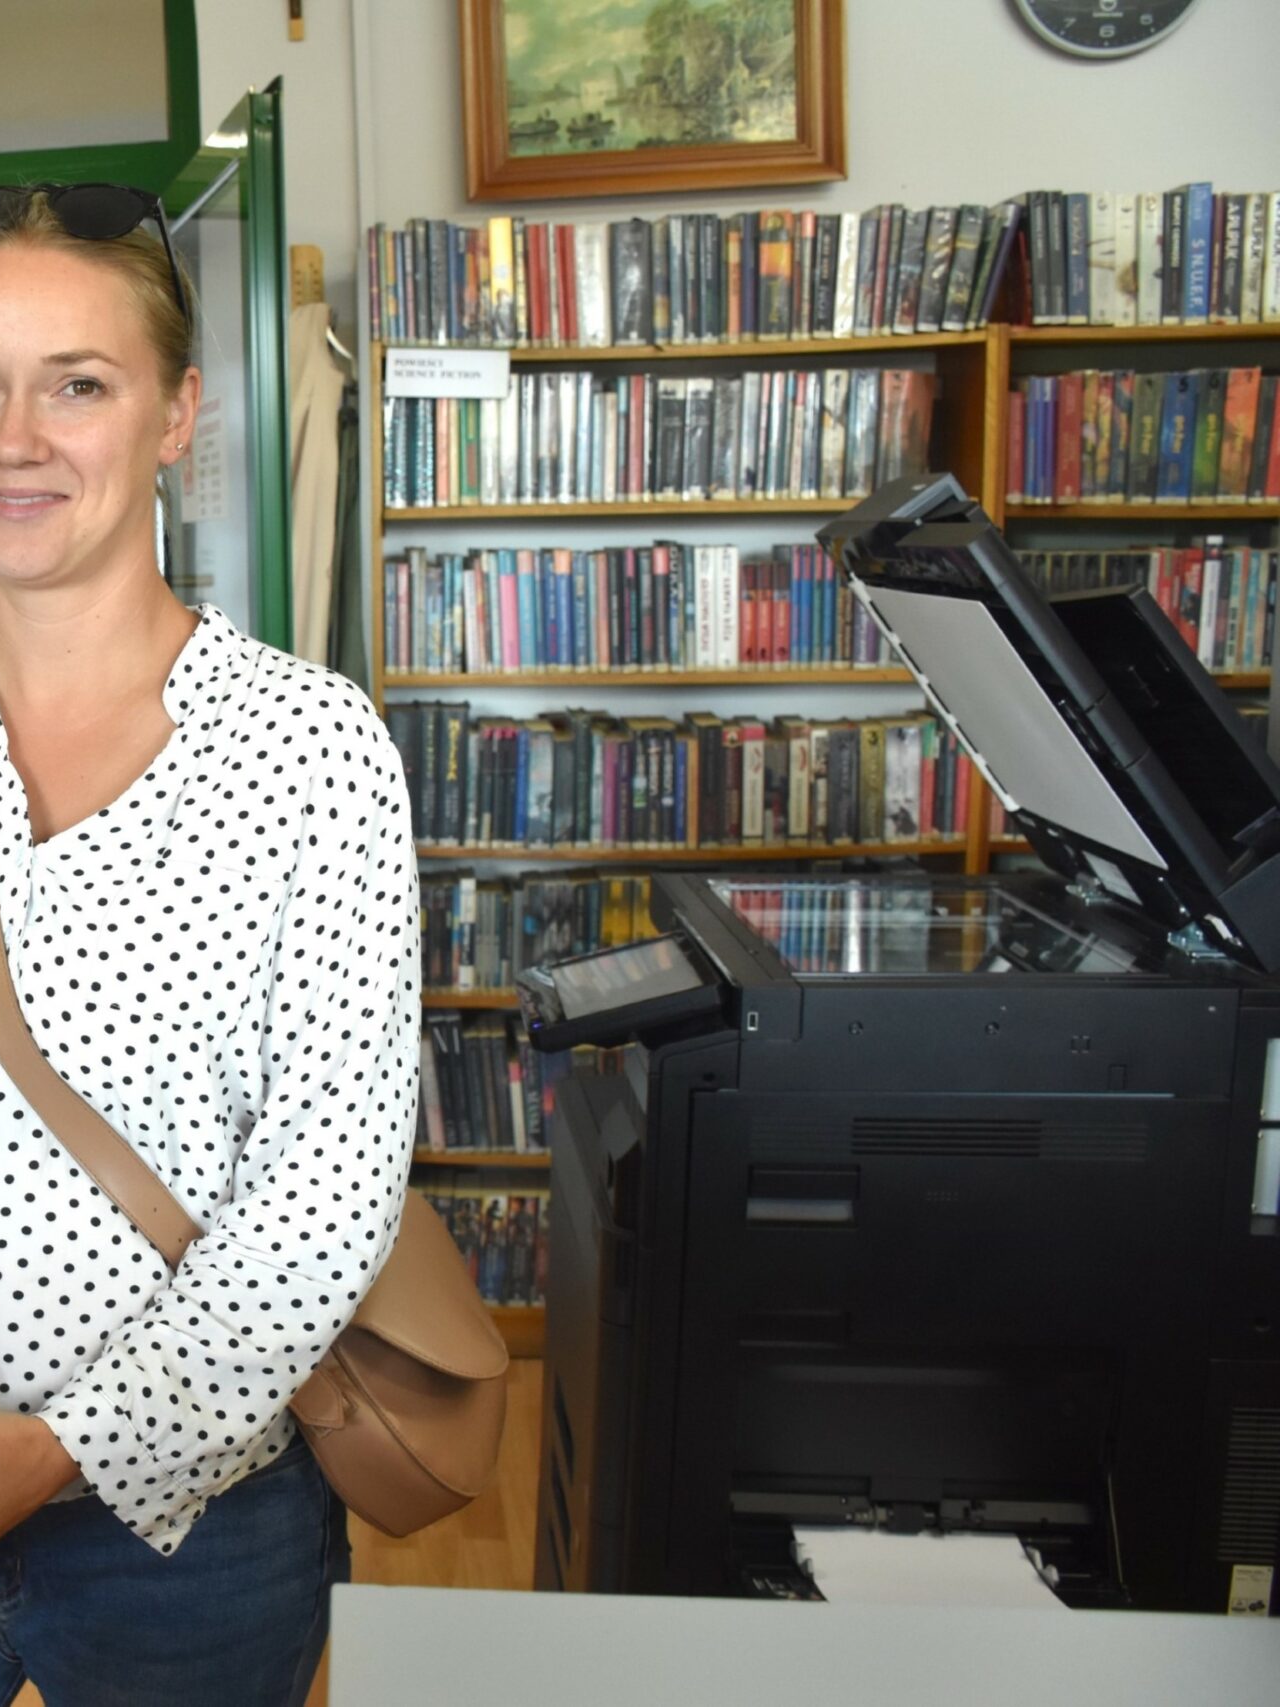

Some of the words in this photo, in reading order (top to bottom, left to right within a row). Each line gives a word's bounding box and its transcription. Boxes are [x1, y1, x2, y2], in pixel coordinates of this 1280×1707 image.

[1099, 25, 1115, 38] 6
[394, 369, 435, 378] SCIENCE
[440, 371, 481, 379] FICTION
